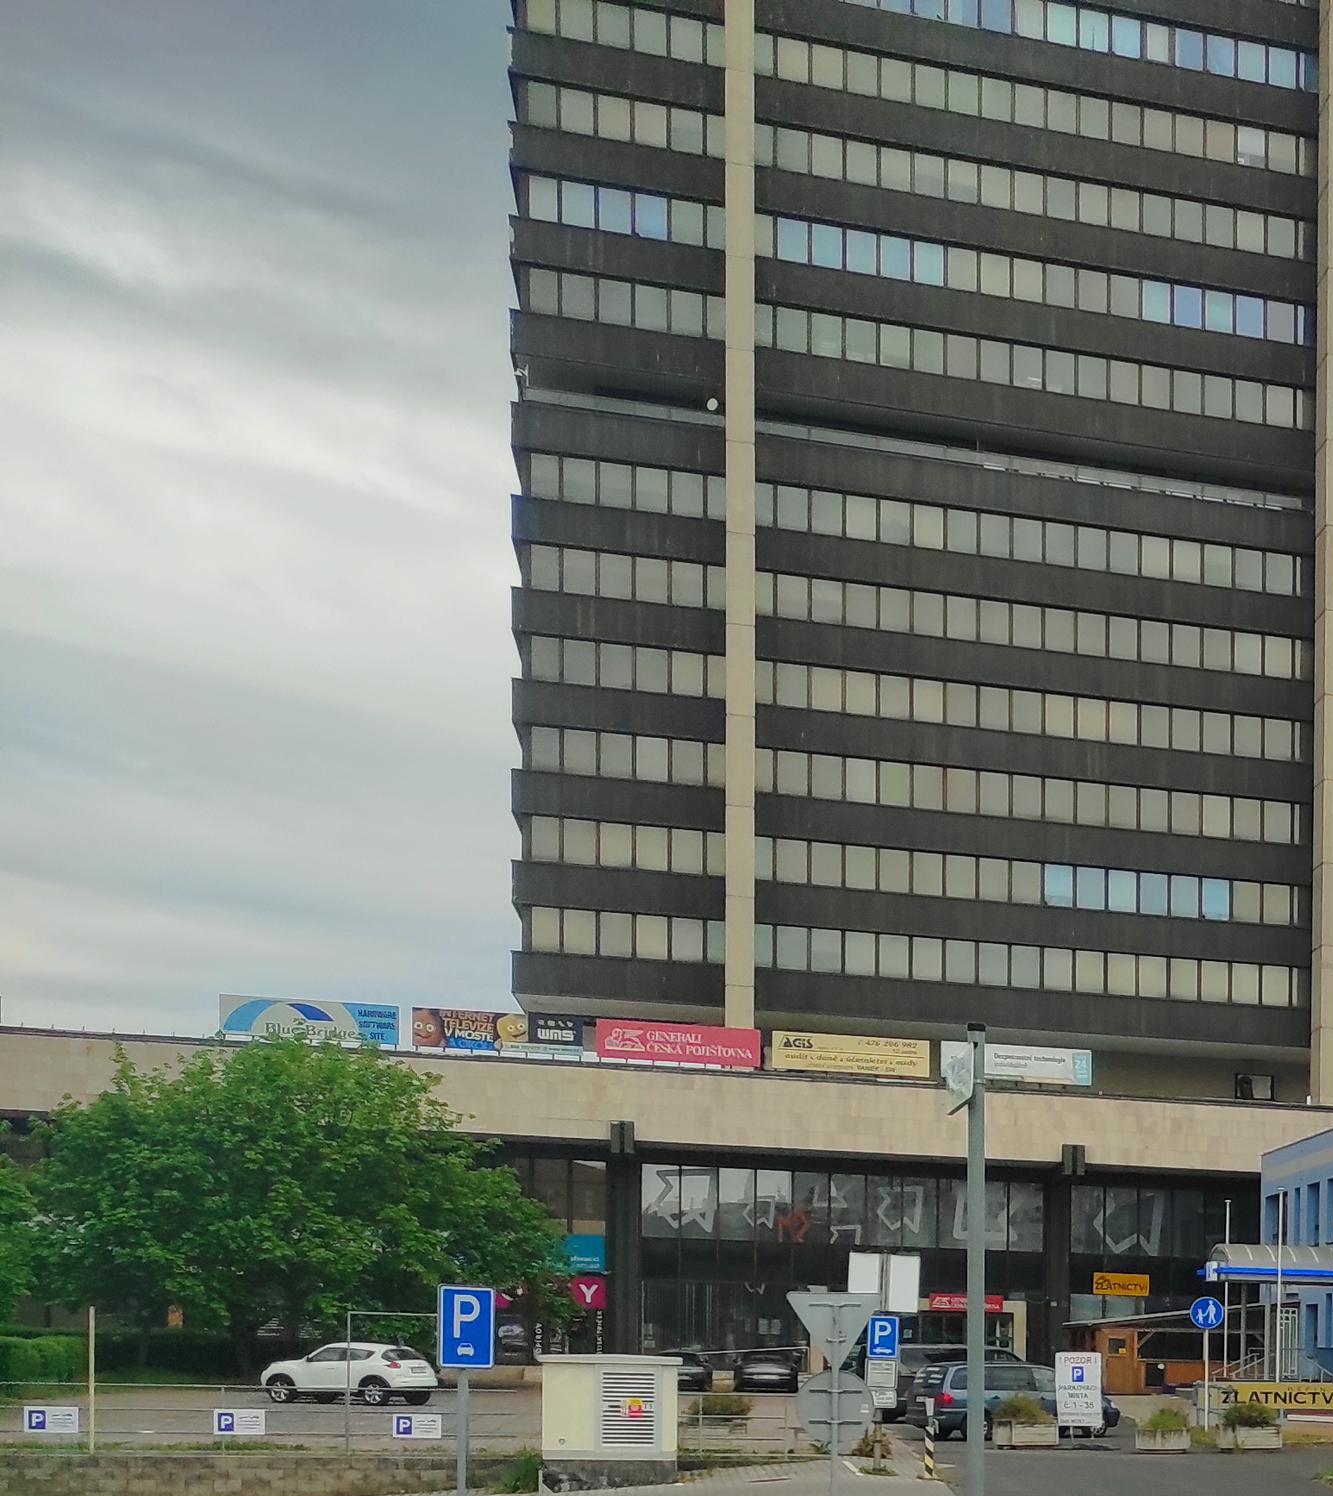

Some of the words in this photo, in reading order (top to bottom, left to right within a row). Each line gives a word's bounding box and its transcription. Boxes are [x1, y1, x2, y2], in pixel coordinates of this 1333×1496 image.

[440, 1010, 495, 1023] INTERNET
[265, 1022, 297, 1037] Blue
[305, 1024, 357, 1040] Bridge
[443, 1017, 495, 1032] TELEVIZE
[444, 1028, 453, 1038] V
[454, 1030, 494, 1043] MOSTE
[537, 1027, 575, 1041] WMS
[646, 1030, 703, 1044] GENERALI
[646, 1041, 682, 1054] ČESKÁ
[686, 1044, 753, 1059] POJIŠŤOVNA
[578, 1284, 599, 1304] Y
[453, 1293, 481, 1339] P
[873, 1320, 892, 1345] P
[1064, 1356, 1092, 1364] POZOR
[1073, 1368, 1082, 1381] P
[31, 1412, 44, 1427] P
[220, 1415, 233, 1429] P
[399, 1418, 411, 1432] P
